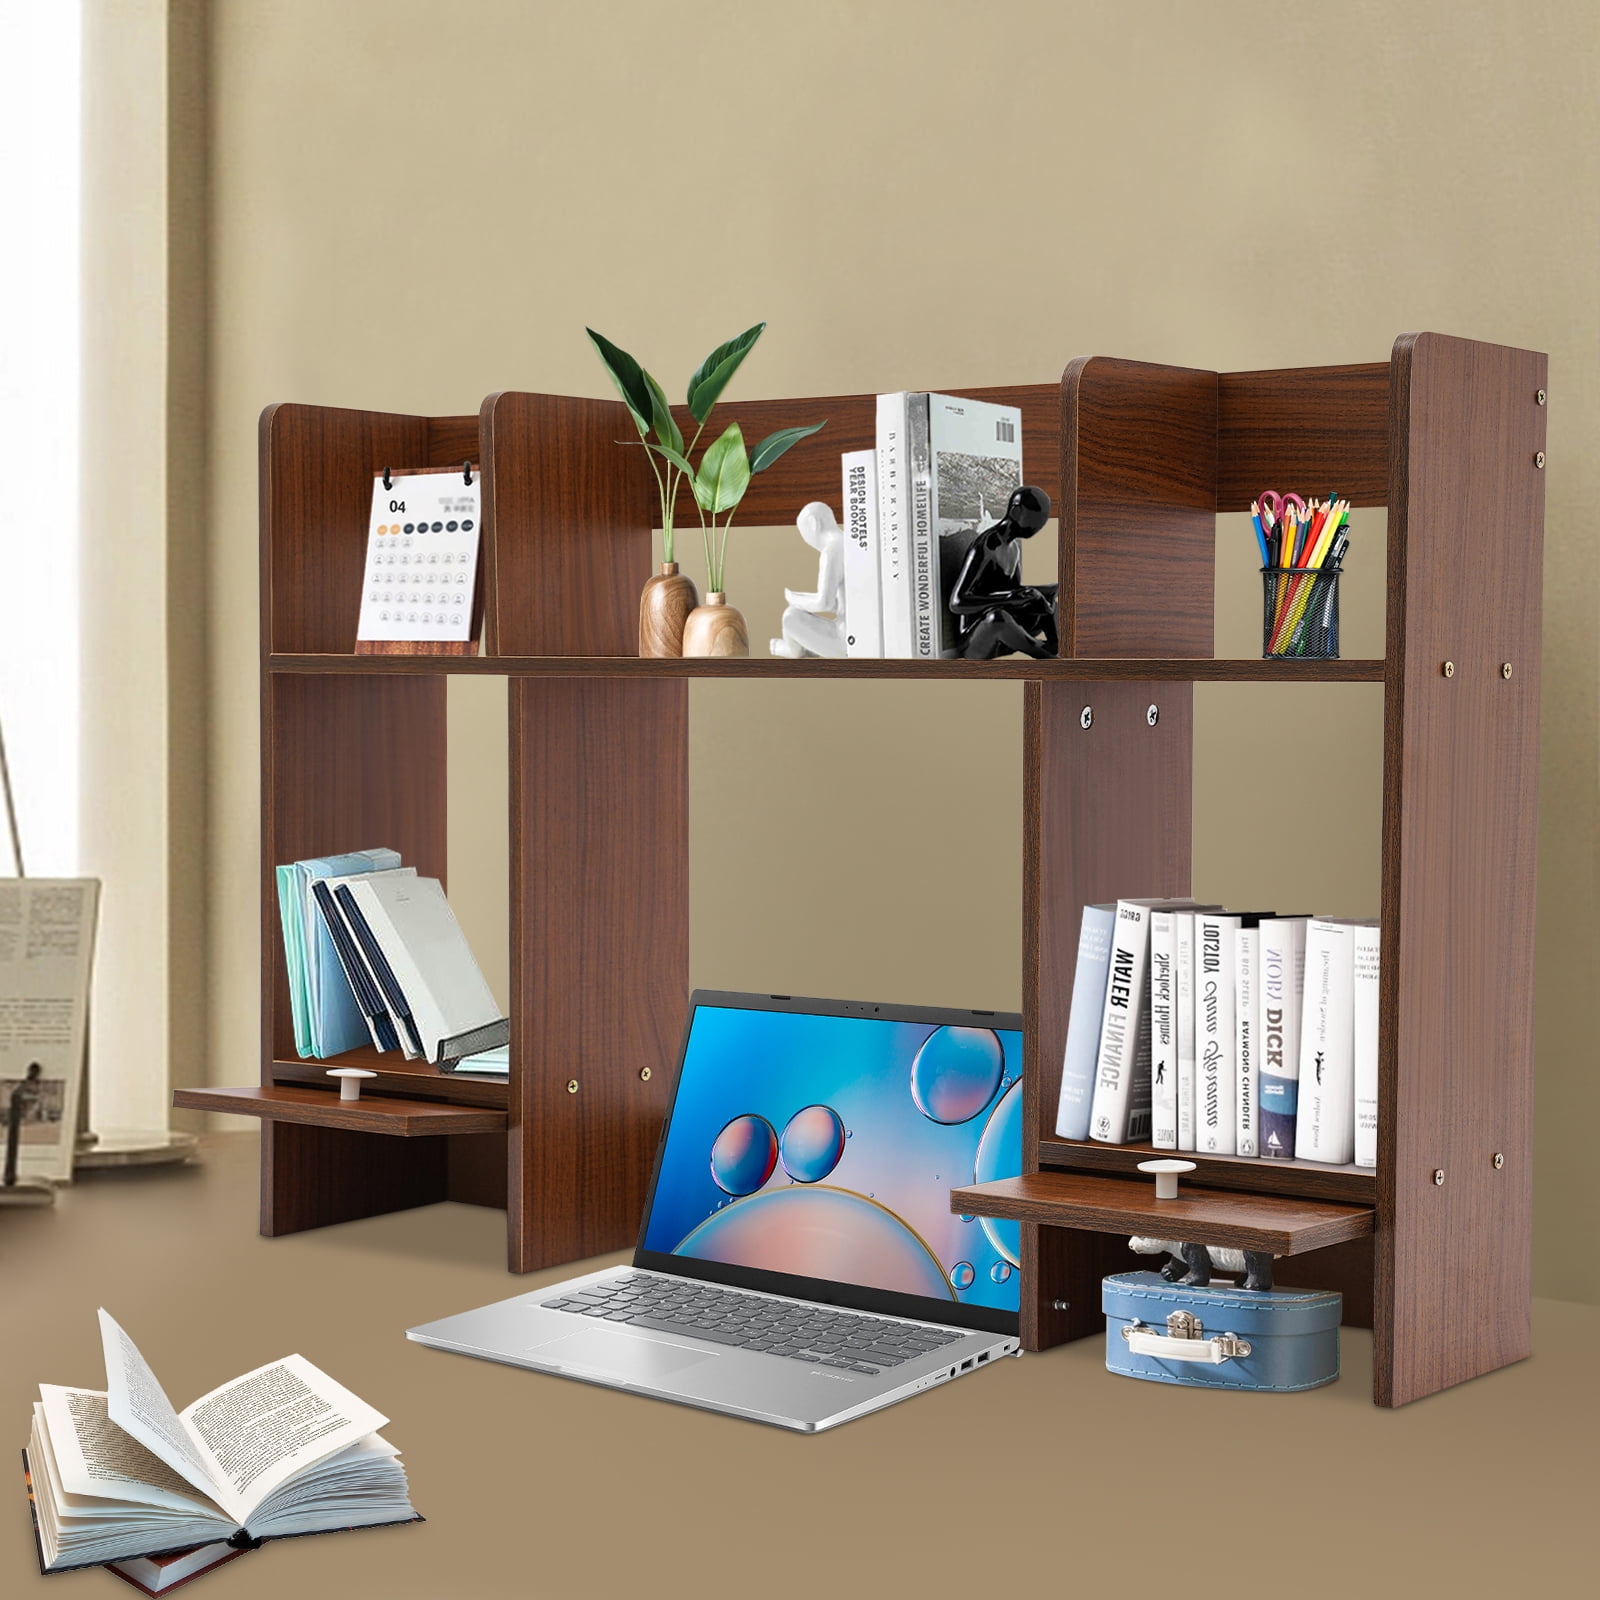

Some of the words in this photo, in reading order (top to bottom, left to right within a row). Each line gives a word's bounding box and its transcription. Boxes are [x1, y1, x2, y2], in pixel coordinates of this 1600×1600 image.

[849, 467, 858, 495] YEAR
[857, 466, 866, 505] DESIGN
[389, 500, 406, 513] 04
[916, 480, 928, 536] HOMELIFE
[859, 507, 868, 549] HOTELS
[918, 541, 930, 611] WONDERFUL
[919, 615, 931, 656] CREATE
